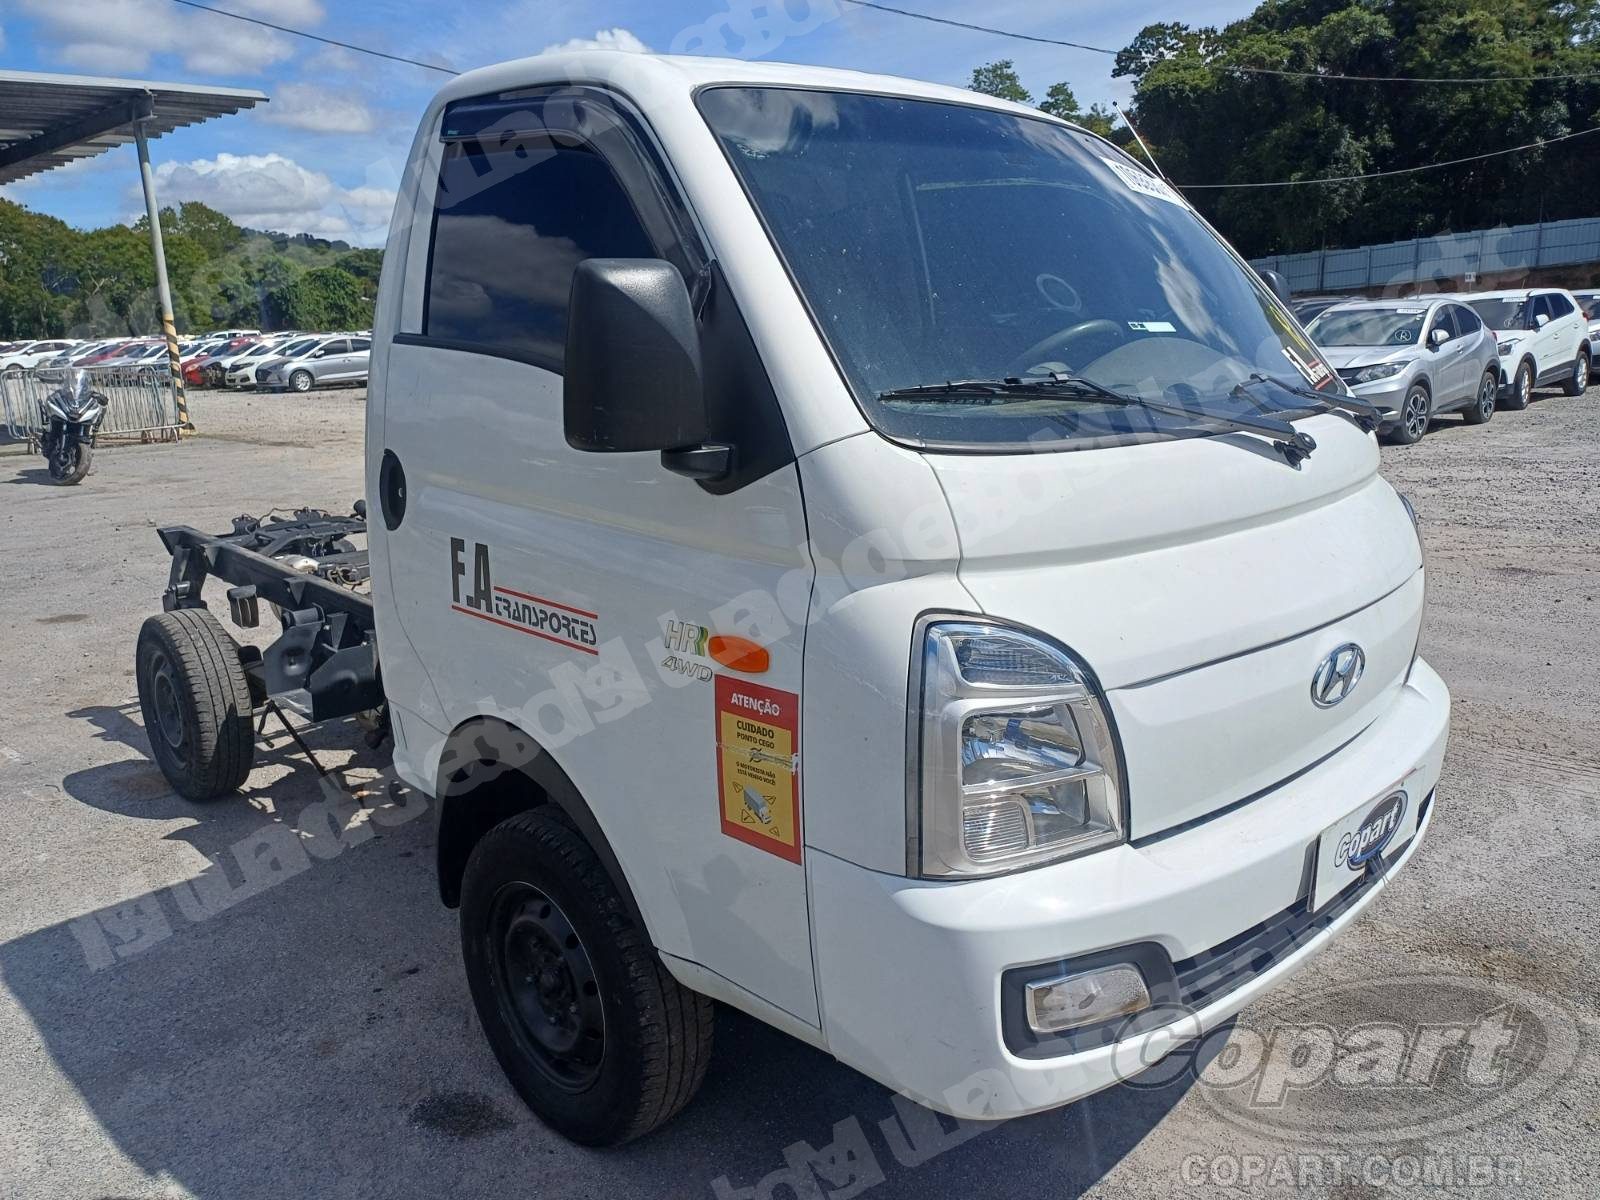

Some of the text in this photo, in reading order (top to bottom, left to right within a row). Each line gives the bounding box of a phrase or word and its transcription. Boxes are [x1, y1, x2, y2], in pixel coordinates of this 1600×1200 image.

[450, 537, 493, 614] F.A
[495, 596, 597, 645] TRANSPORTES
[664, 620, 706, 657] HR
[662, 656, 712, 682] 4WD
[731, 693, 780, 717] ATENÇÃO
[736, 720, 775, 739] CUIDADO
[736, 732, 775, 749] PONTO CEGO
